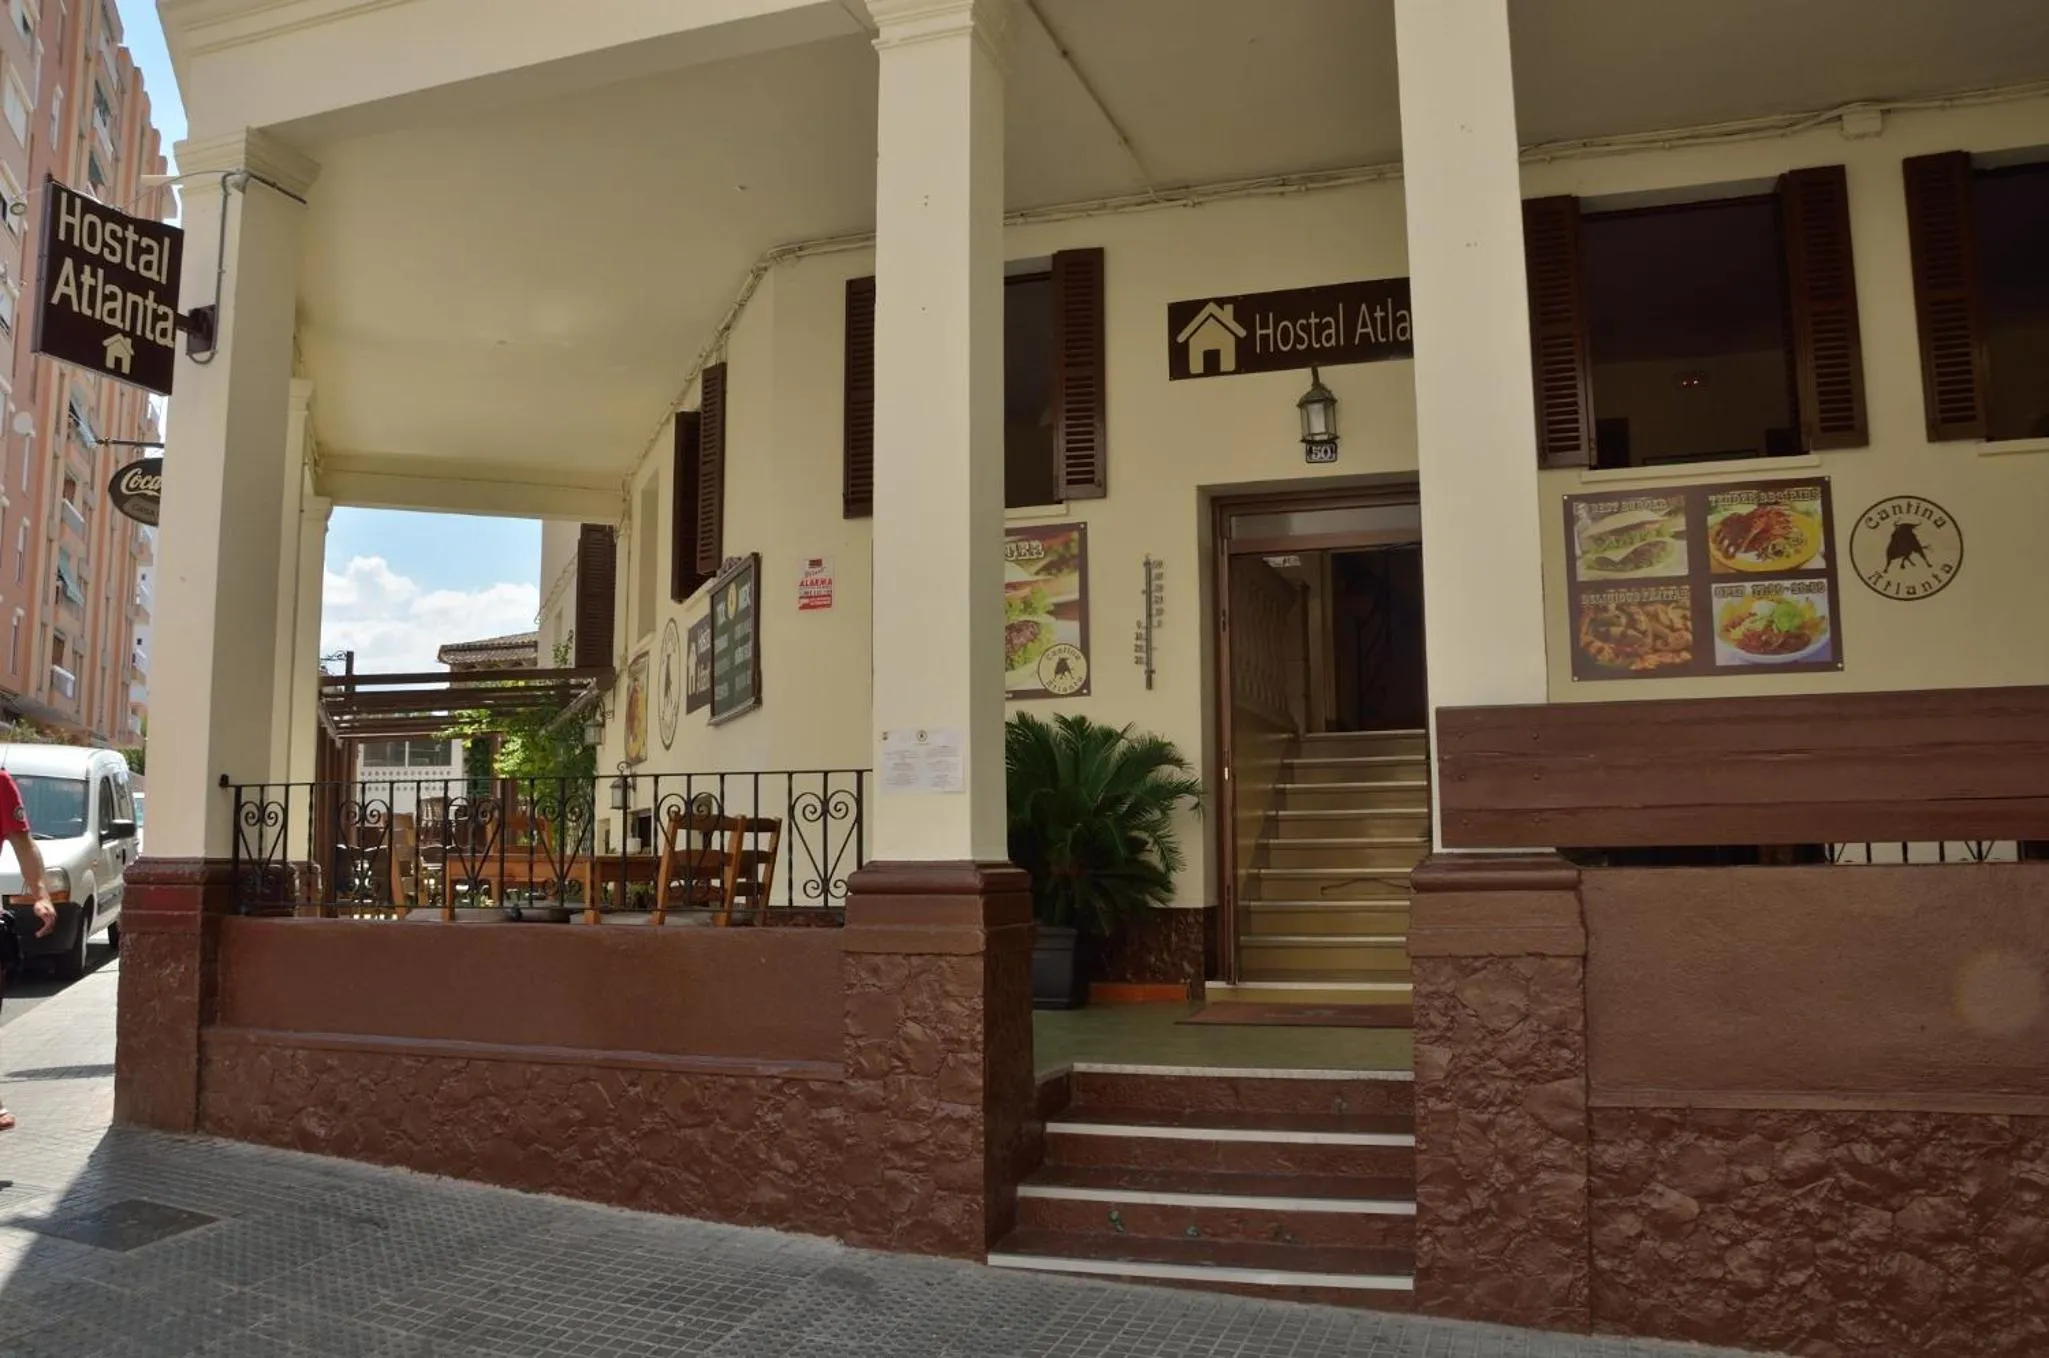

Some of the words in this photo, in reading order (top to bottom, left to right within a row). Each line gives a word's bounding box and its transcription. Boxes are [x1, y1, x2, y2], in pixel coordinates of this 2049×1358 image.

[58, 192, 170, 285] Hostal
[51, 257, 175, 348] Atlanta
[1256, 302, 1344, 354] Hostal
[1354, 298, 1411, 346] Atla
[120, 467, 162, 495] Coca
[1865, 501, 1947, 529] Cantina
[1868, 563, 1953, 596] Atlanta
